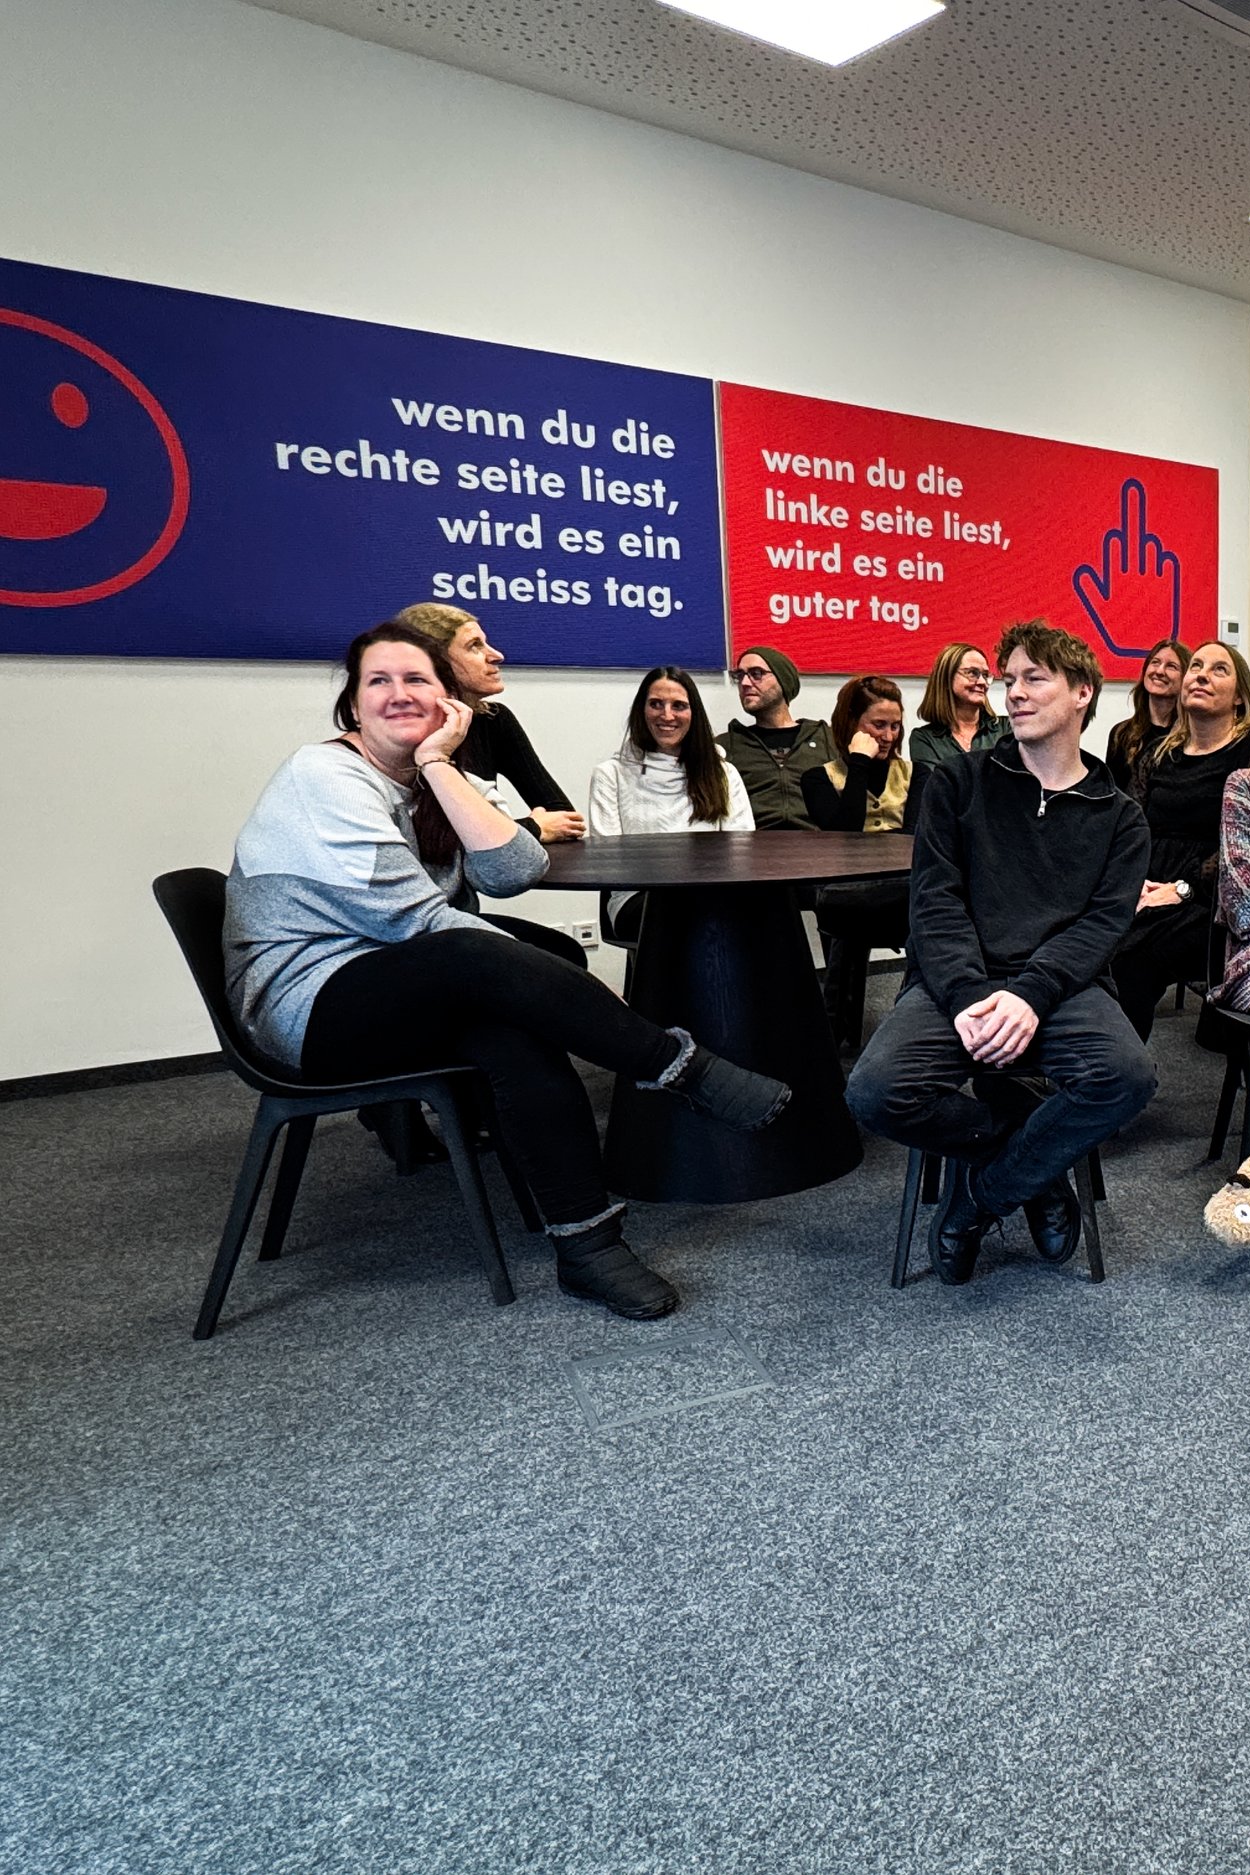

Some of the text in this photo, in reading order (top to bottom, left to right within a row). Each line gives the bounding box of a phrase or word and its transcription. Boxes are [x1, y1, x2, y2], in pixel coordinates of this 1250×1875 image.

[392, 399, 675, 458] wenn du die
[277, 440, 678, 515] rechte seite liest,
[762, 450, 963, 497] wenn du die
[438, 510, 680, 560] wird es ein
[766, 488, 1010, 550] linke seite liest,
[766, 540, 943, 581] wird es ein
[433, 564, 683, 617] scheiss tag.
[770, 592, 928, 630] guter tag.
